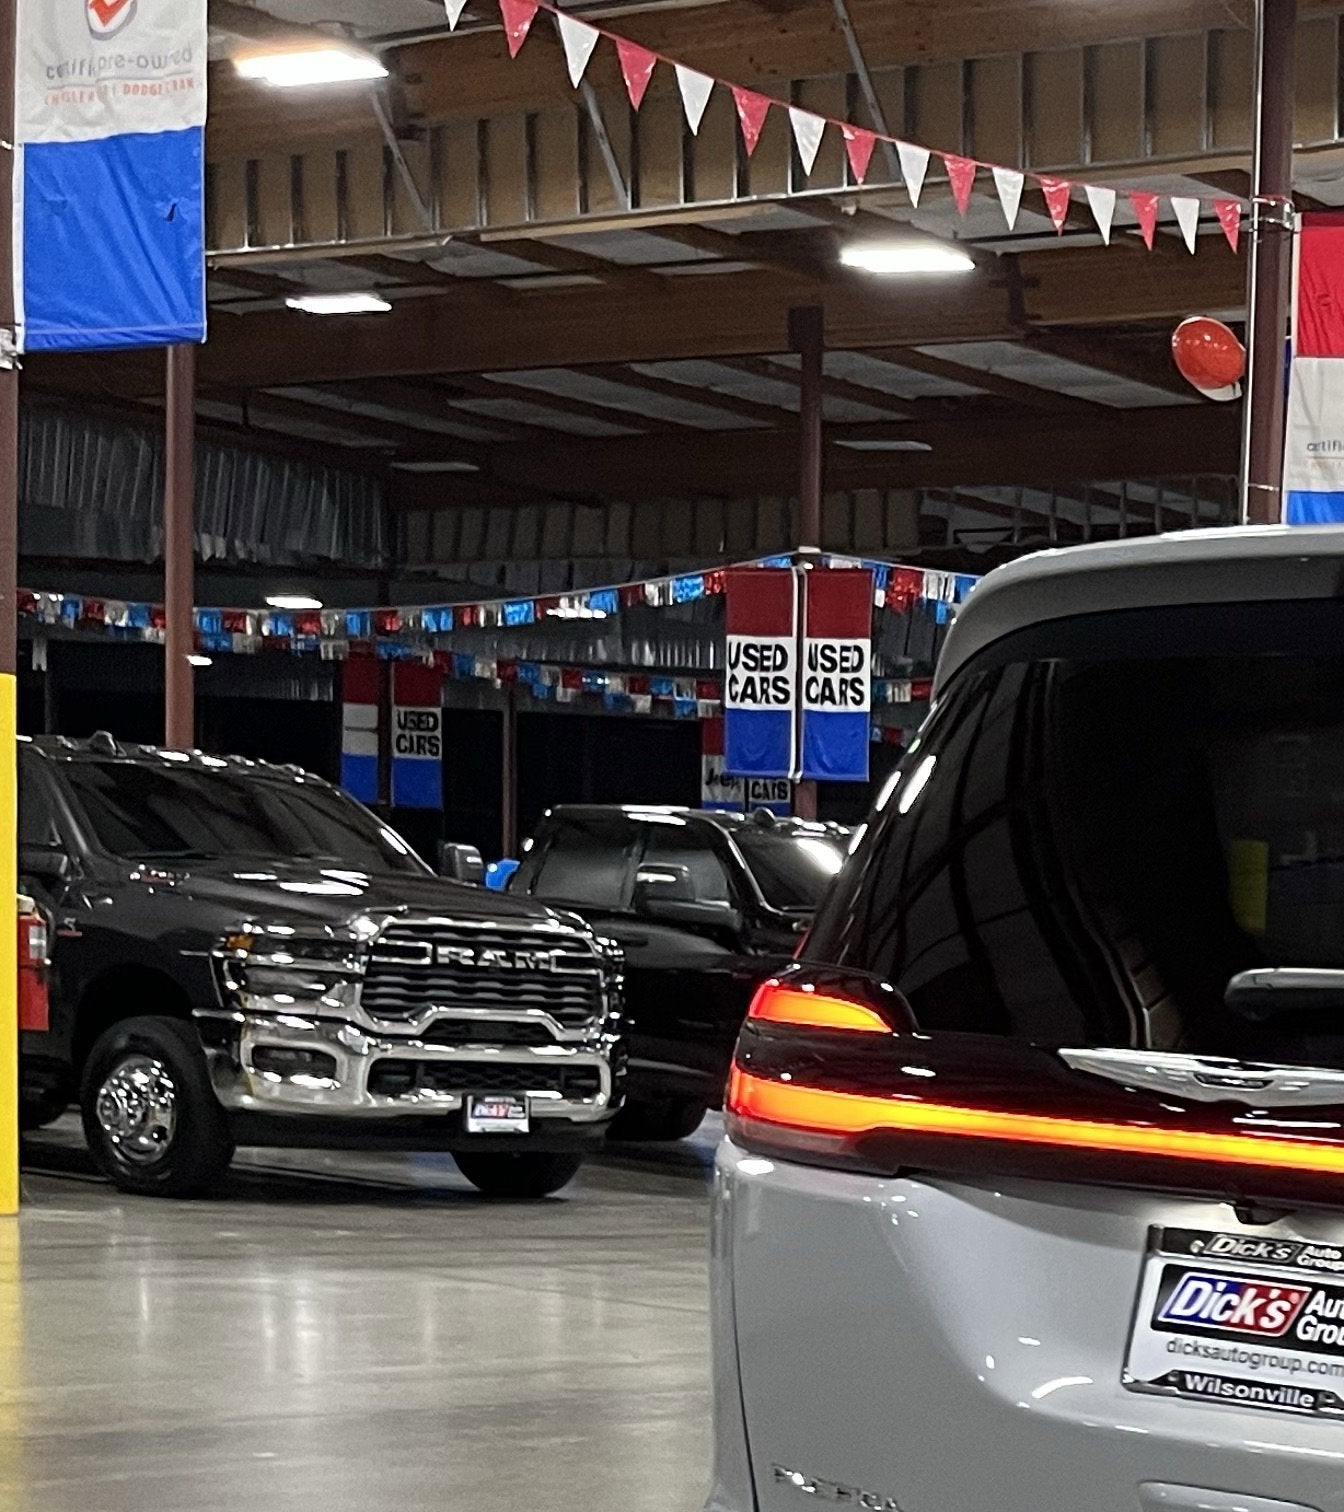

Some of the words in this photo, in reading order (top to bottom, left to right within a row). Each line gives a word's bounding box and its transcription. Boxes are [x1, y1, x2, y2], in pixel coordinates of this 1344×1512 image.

[46, 57, 96, 80] cetifi
[97, 41, 193, 75] pre-owed
[728, 641, 789, 672] USED
[807, 643, 865, 673] USED
[728, 673, 791, 705] CARS
[805, 676, 865, 706] CARS
[397, 709, 440, 732] USED
[437, 945, 550, 970] RAM
[1212, 1237, 1293, 1260] Dick's
[1301, 1245, 1342, 1260] Auto
[1169, 1278, 1292, 1330] Dick's
[1183, 1372, 1316, 1408] Wilsonville
